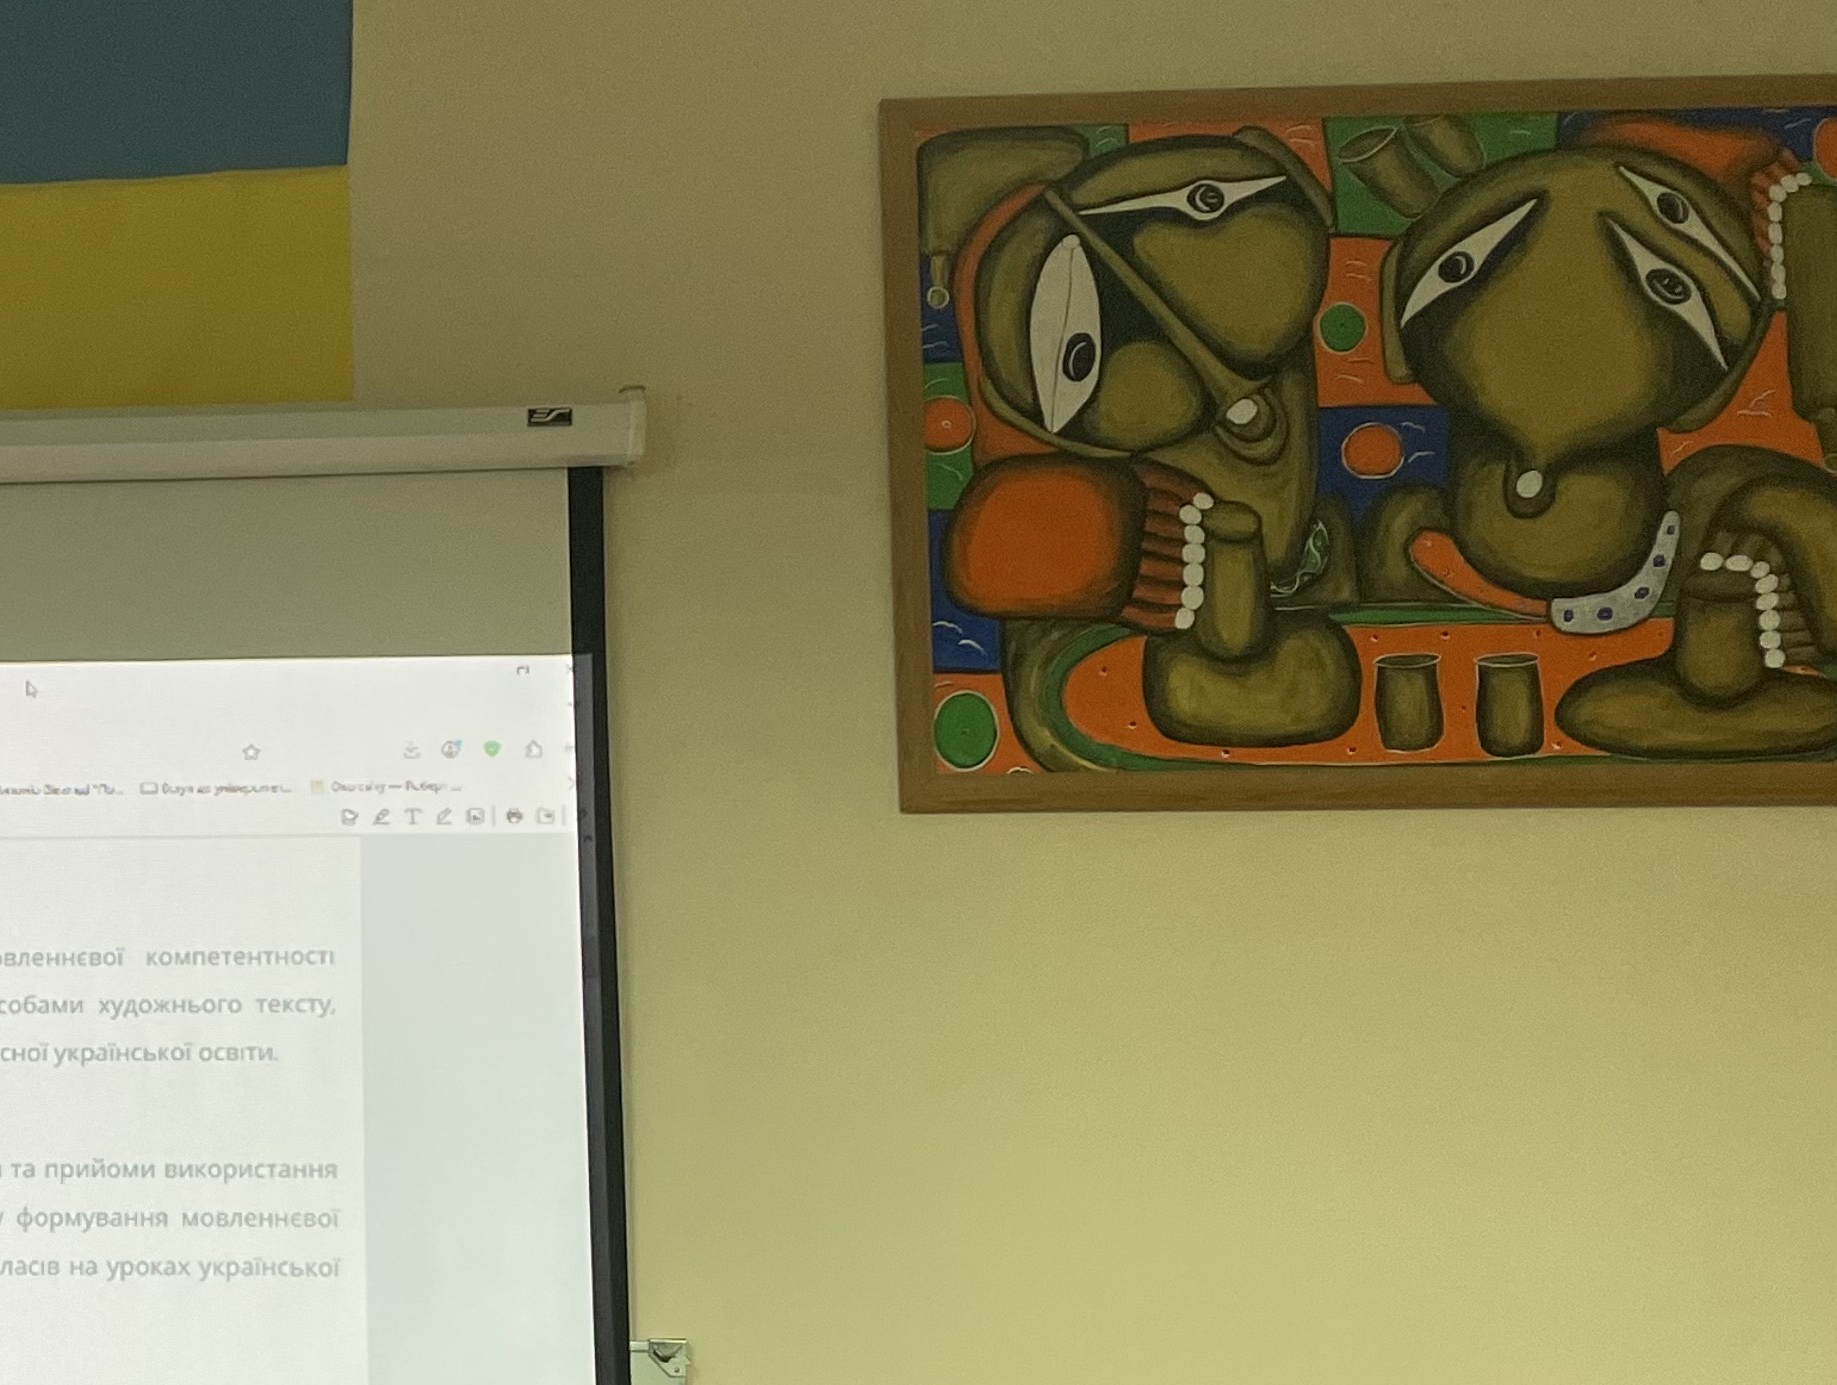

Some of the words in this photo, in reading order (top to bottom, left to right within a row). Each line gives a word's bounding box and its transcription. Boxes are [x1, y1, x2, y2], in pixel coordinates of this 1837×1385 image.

[146, 947, 336, 966] компетентності
[98, 996, 243, 1019] художнього
[255, 995, 337, 1018] тексту,
[54, 1040, 195, 1067] української
[199, 1044, 279, 1062] освіти.
[11, 1160, 36, 1178] та
[44, 1156, 156, 1183] прийоми
[164, 1159, 339, 1183] використання
[16, 1205, 169, 1232] формування
[181, 1207, 341, 1227] мовленнєвої
[69, 1258, 98, 1276] на
[106, 1258, 191, 1281] уроках
[198, 1256, 342, 1282] української
